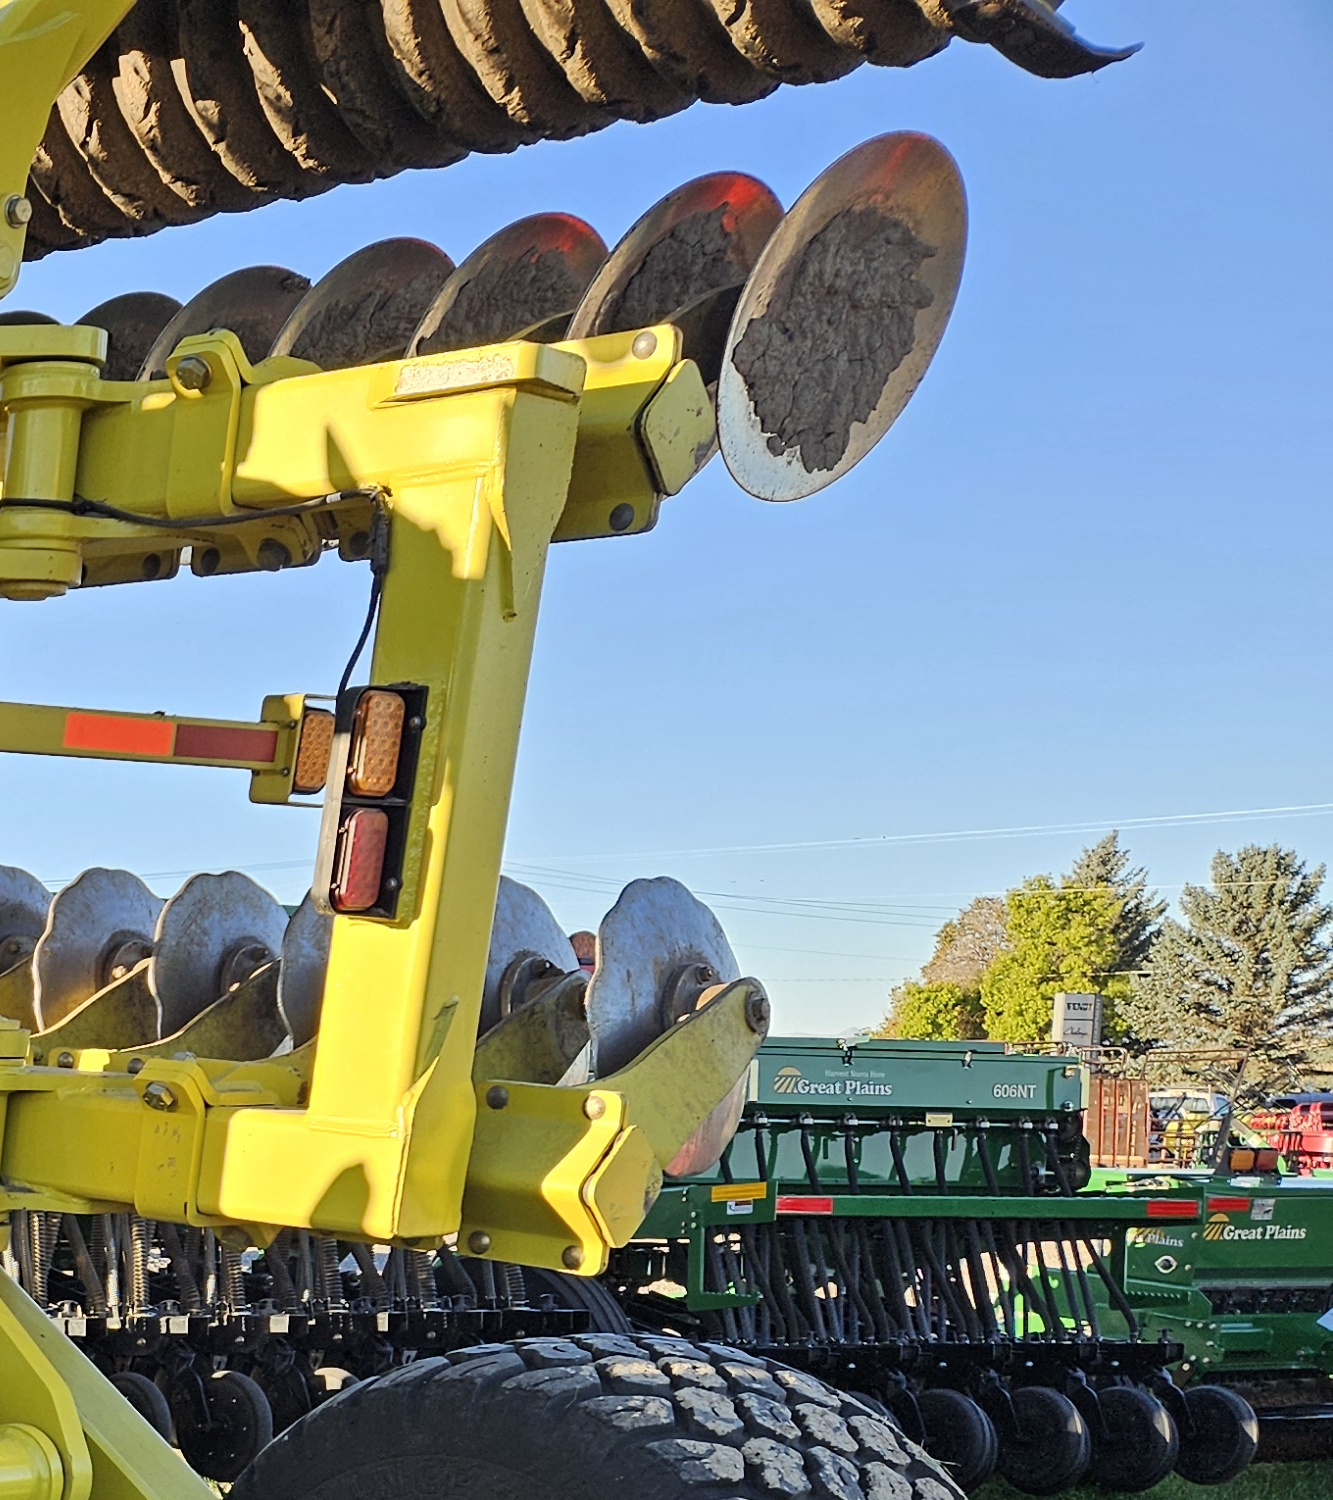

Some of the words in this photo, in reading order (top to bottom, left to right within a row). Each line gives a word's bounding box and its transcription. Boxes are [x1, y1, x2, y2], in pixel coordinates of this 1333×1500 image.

[797, 1079, 842, 1095] Great
[844, 1080, 893, 1097] Plains
[993, 1084, 1037, 1099] 606NT
[1146, 1232, 1184, 1248] Plains
[1222, 1225, 1262, 1240] Great
[1264, 1224, 1306, 1240] Plains
